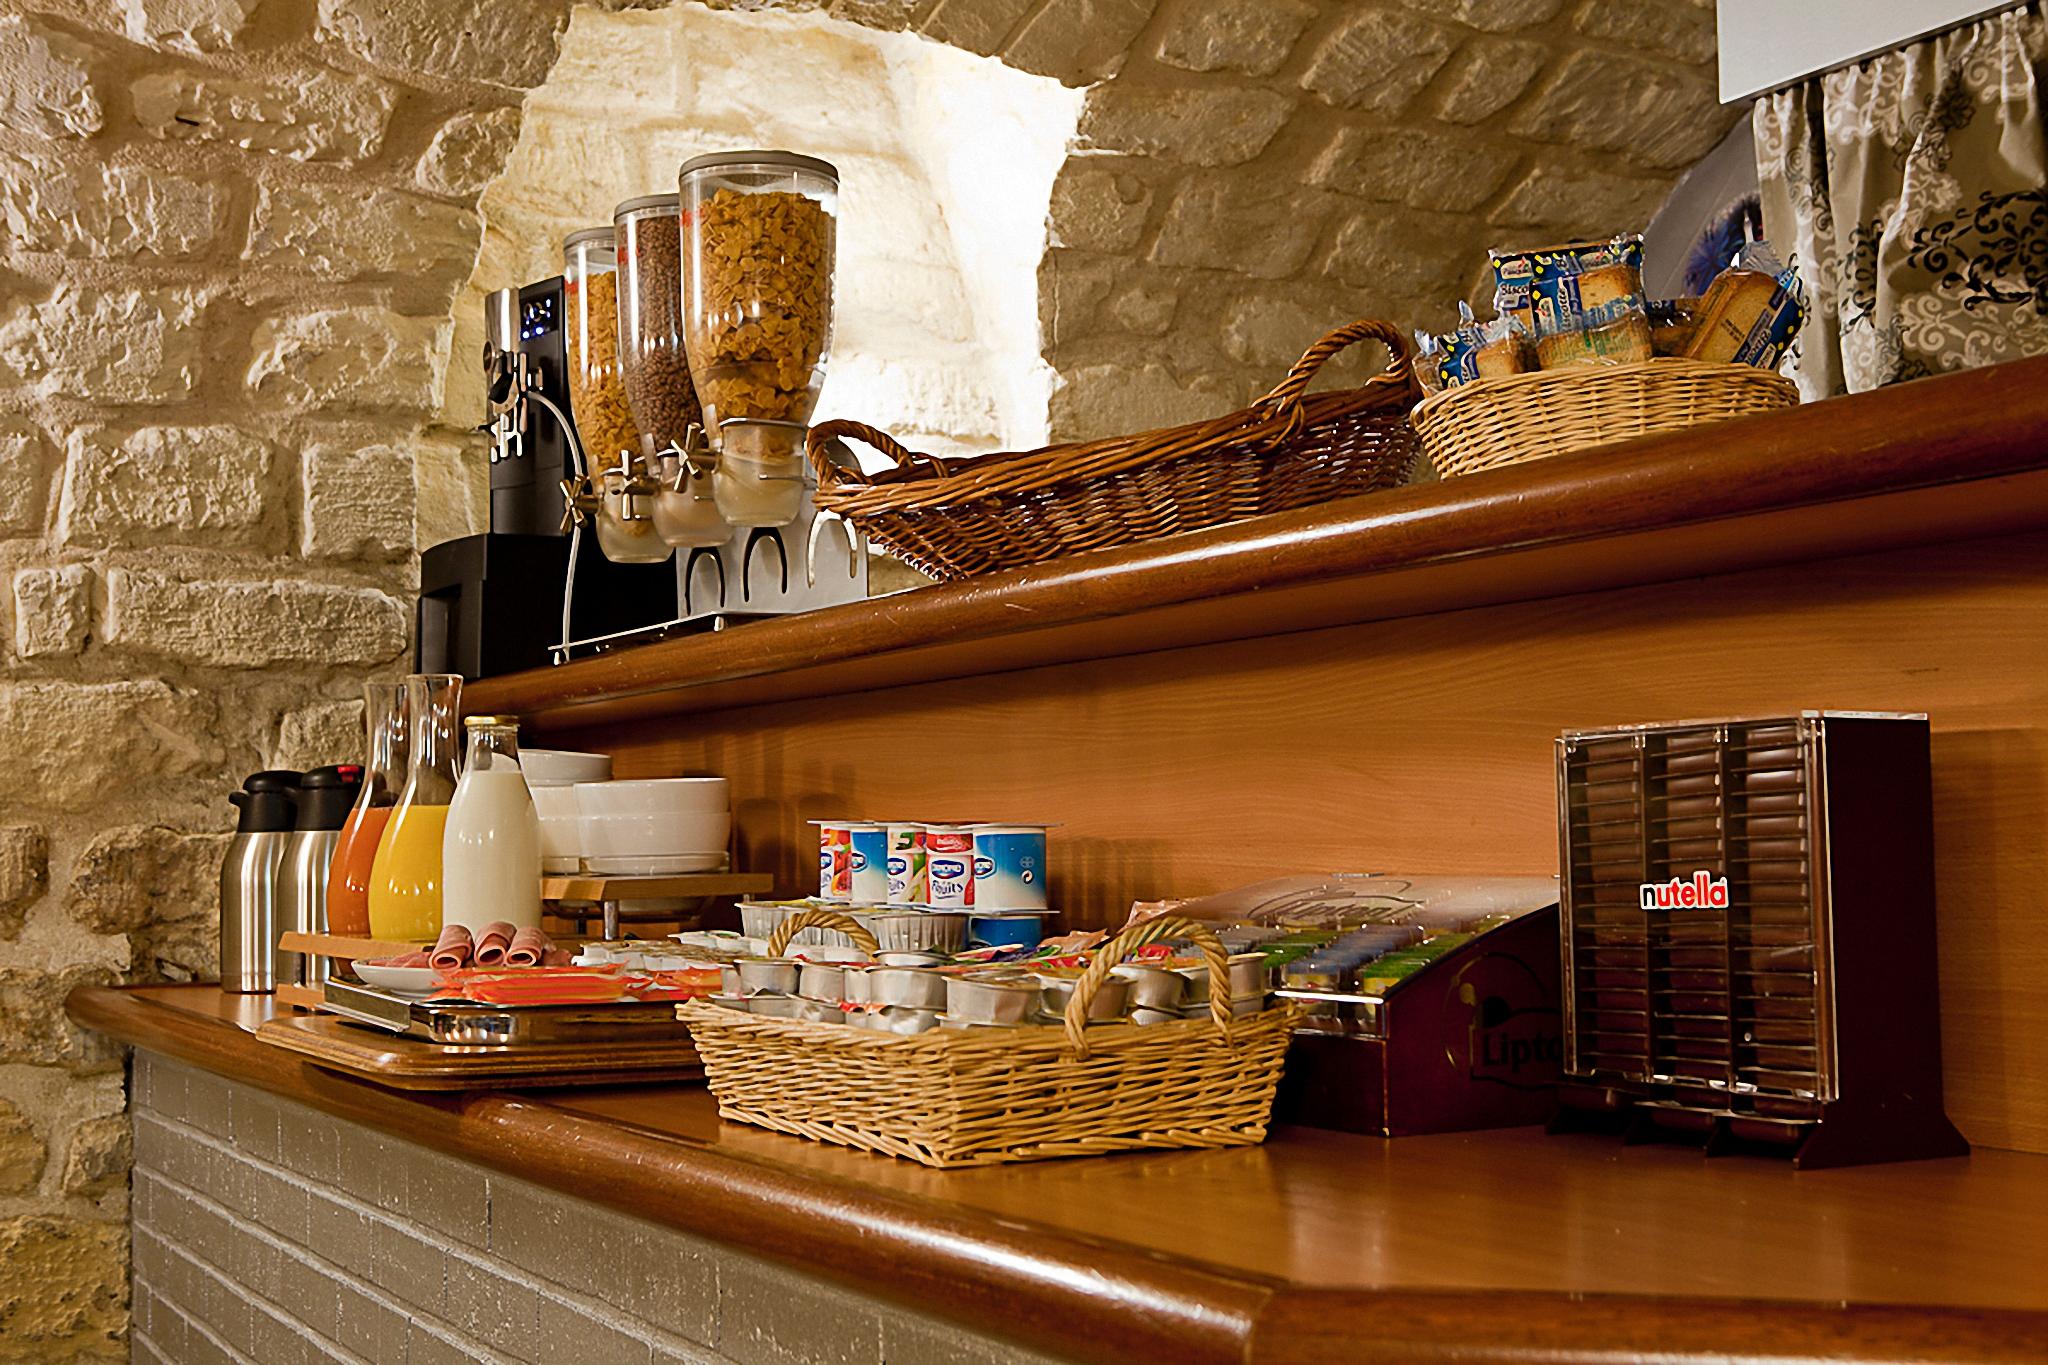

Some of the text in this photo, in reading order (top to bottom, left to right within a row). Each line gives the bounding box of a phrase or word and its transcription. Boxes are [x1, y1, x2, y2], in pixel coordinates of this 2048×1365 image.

[1500, 283, 1529, 296] Bisco
[1643, 874, 1726, 906] nutella
[1275, 902, 1393, 920] Lipton
[1484, 1032, 1563, 1074] Lipto
